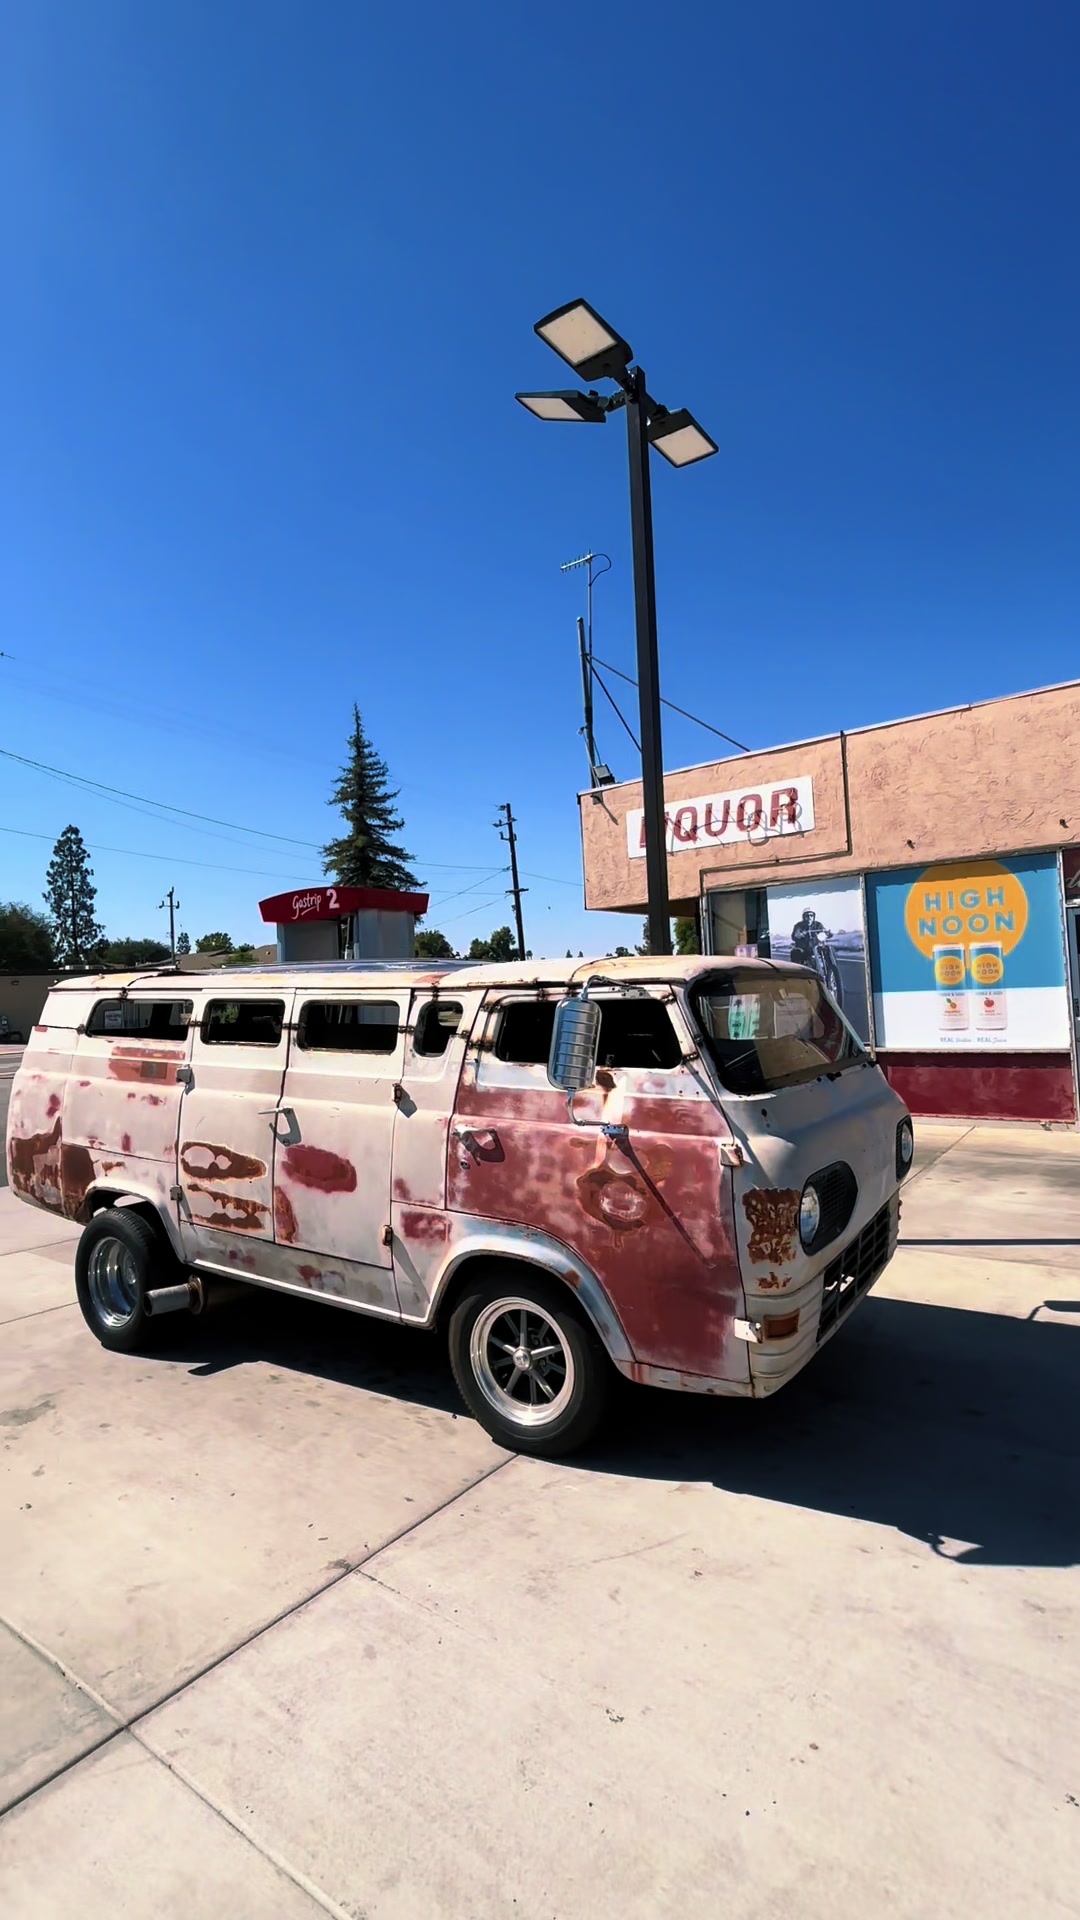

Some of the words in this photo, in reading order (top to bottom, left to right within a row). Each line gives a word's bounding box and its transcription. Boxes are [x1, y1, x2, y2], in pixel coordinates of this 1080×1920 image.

[639, 787, 799, 849] QUOR
[291, 893, 322, 920] Gastrip
[326, 888, 340, 909] 2
[924, 886, 1005, 912] HIGH
[918, 911, 1016, 937] NOON
